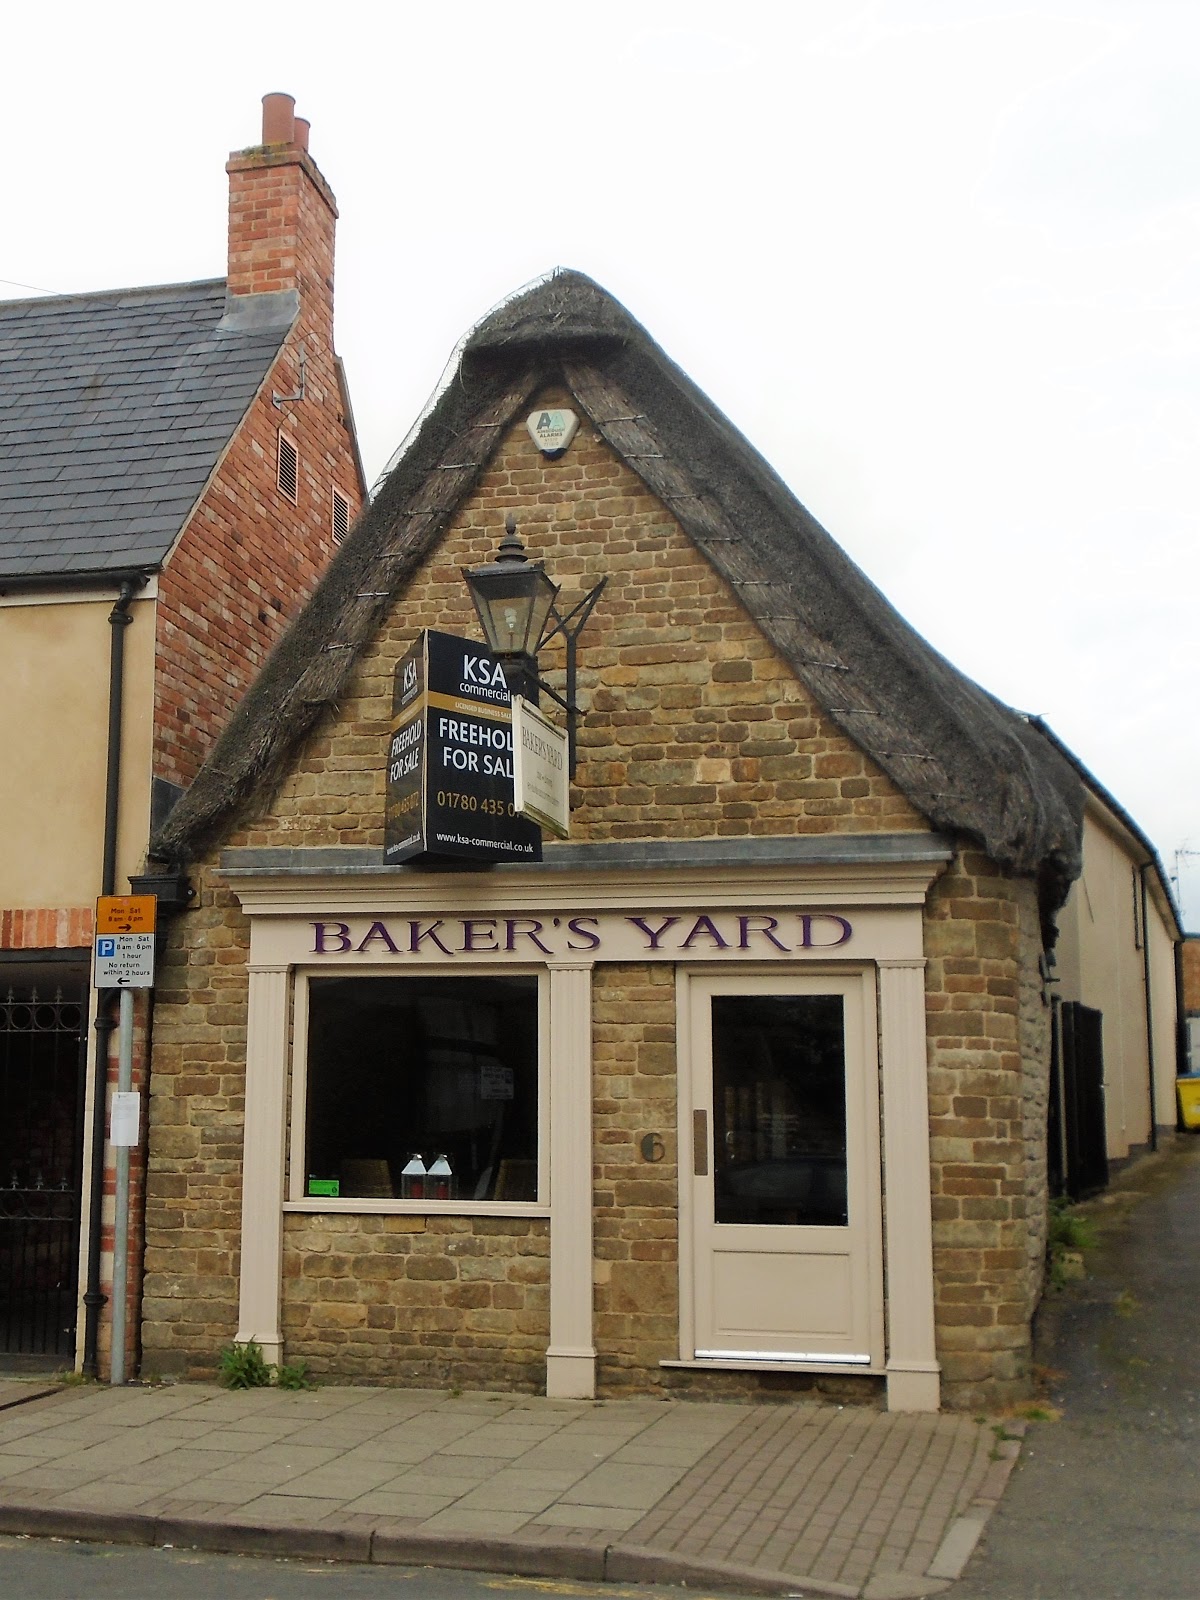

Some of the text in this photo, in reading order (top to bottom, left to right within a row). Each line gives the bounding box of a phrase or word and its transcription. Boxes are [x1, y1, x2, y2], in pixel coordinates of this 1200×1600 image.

[404, 658, 417, 692] KSA
[463, 654, 507, 689] KSA
[460, 682, 511, 702] commercial
[455, 702, 478, 712] LICENSED
[478, 706, 500, 717] BUSINESS
[390, 719, 422, 758] FREEHOLD
[440, 718, 514, 752] FREEHOL
[390, 746, 419, 784] FOR SALE
[443, 746, 514, 779] FOR SAL
[437, 790, 478, 812] 01780
[480, 798, 504, 816] 435
[436, 833, 534, 853] www.ksa-commercial.co.uk
[102, 940, 113, 956] P
[308, 914, 853, 955] BAKER'S YARD
[641, 1132, 665, 1162] 6
